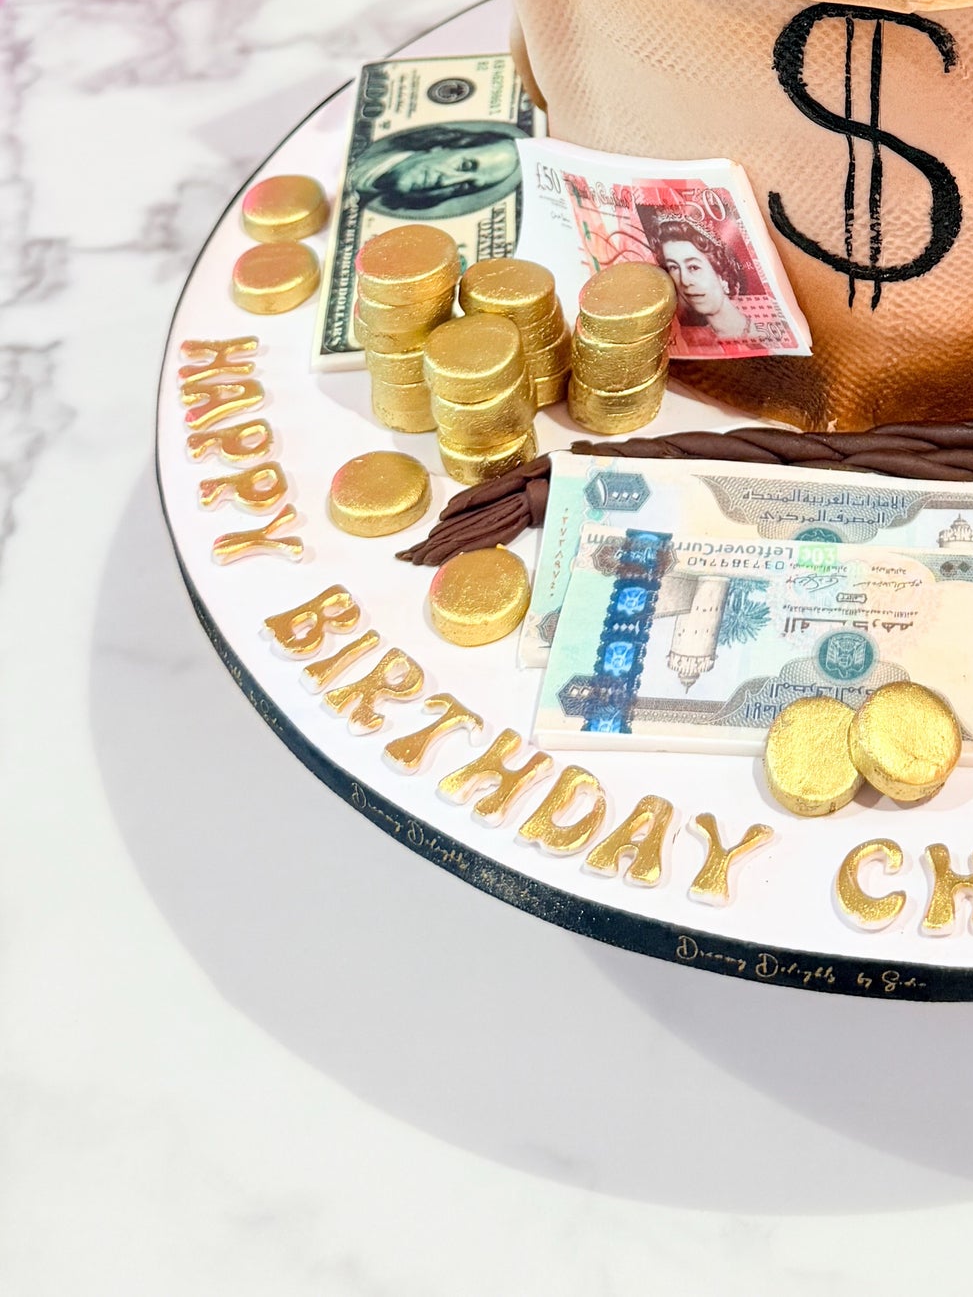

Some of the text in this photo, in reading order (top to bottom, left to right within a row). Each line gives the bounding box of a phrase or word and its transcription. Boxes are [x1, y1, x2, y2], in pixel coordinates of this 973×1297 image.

[536, 162, 561, 195] £50
[681, 188, 726, 222] 50
[178, 335, 306, 566] HAPPY
[258, 584, 775, 908] BIRTHDAY
